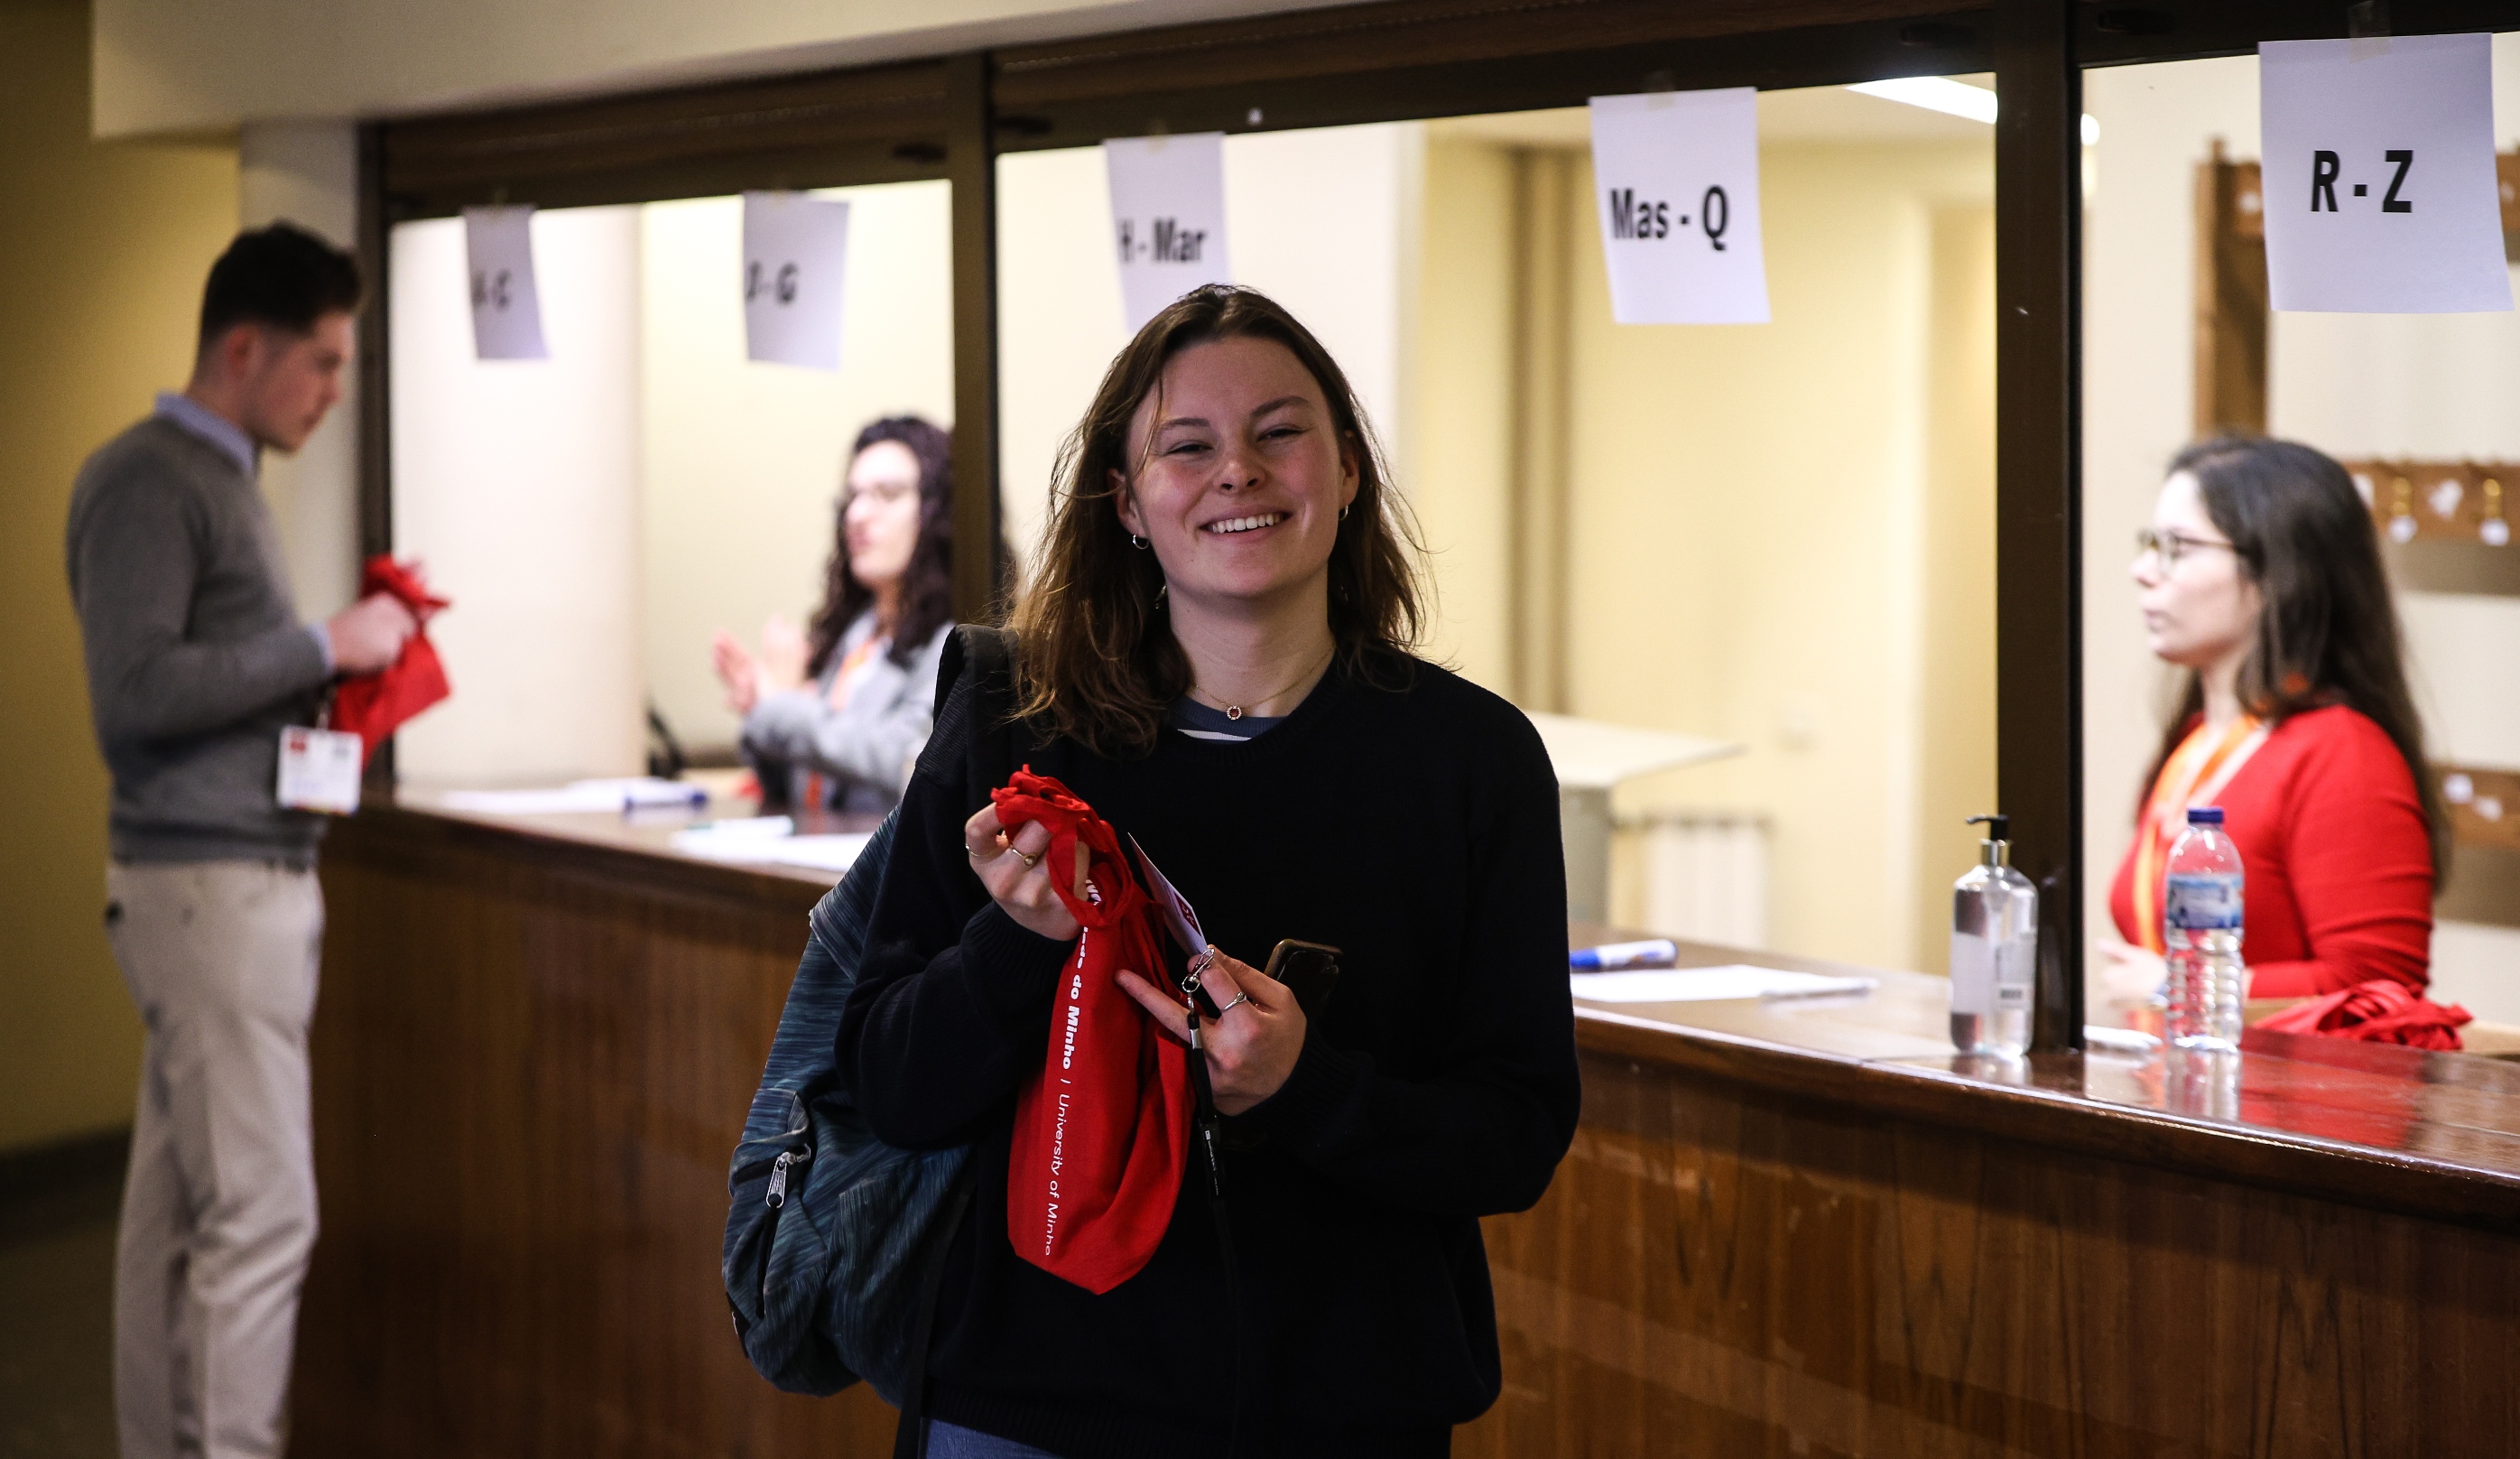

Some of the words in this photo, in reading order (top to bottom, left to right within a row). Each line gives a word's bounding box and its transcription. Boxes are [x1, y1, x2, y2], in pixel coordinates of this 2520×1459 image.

[2311, 150, 2340, 212] R
[2382, 150, 2413, 213] Z
[1153, 218, 1207, 262] Mar
[1610, 188, 1669, 239] Mas
[1703, 184, 1728, 251] Q
[1070, 974, 1082, 999] do
[1062, 1005, 1080, 1070] Minho
[1051, 1093, 1070, 1176] University
[1049, 1180, 1060, 1199] of
[1044, 1203, 1059, 1256] Minho
